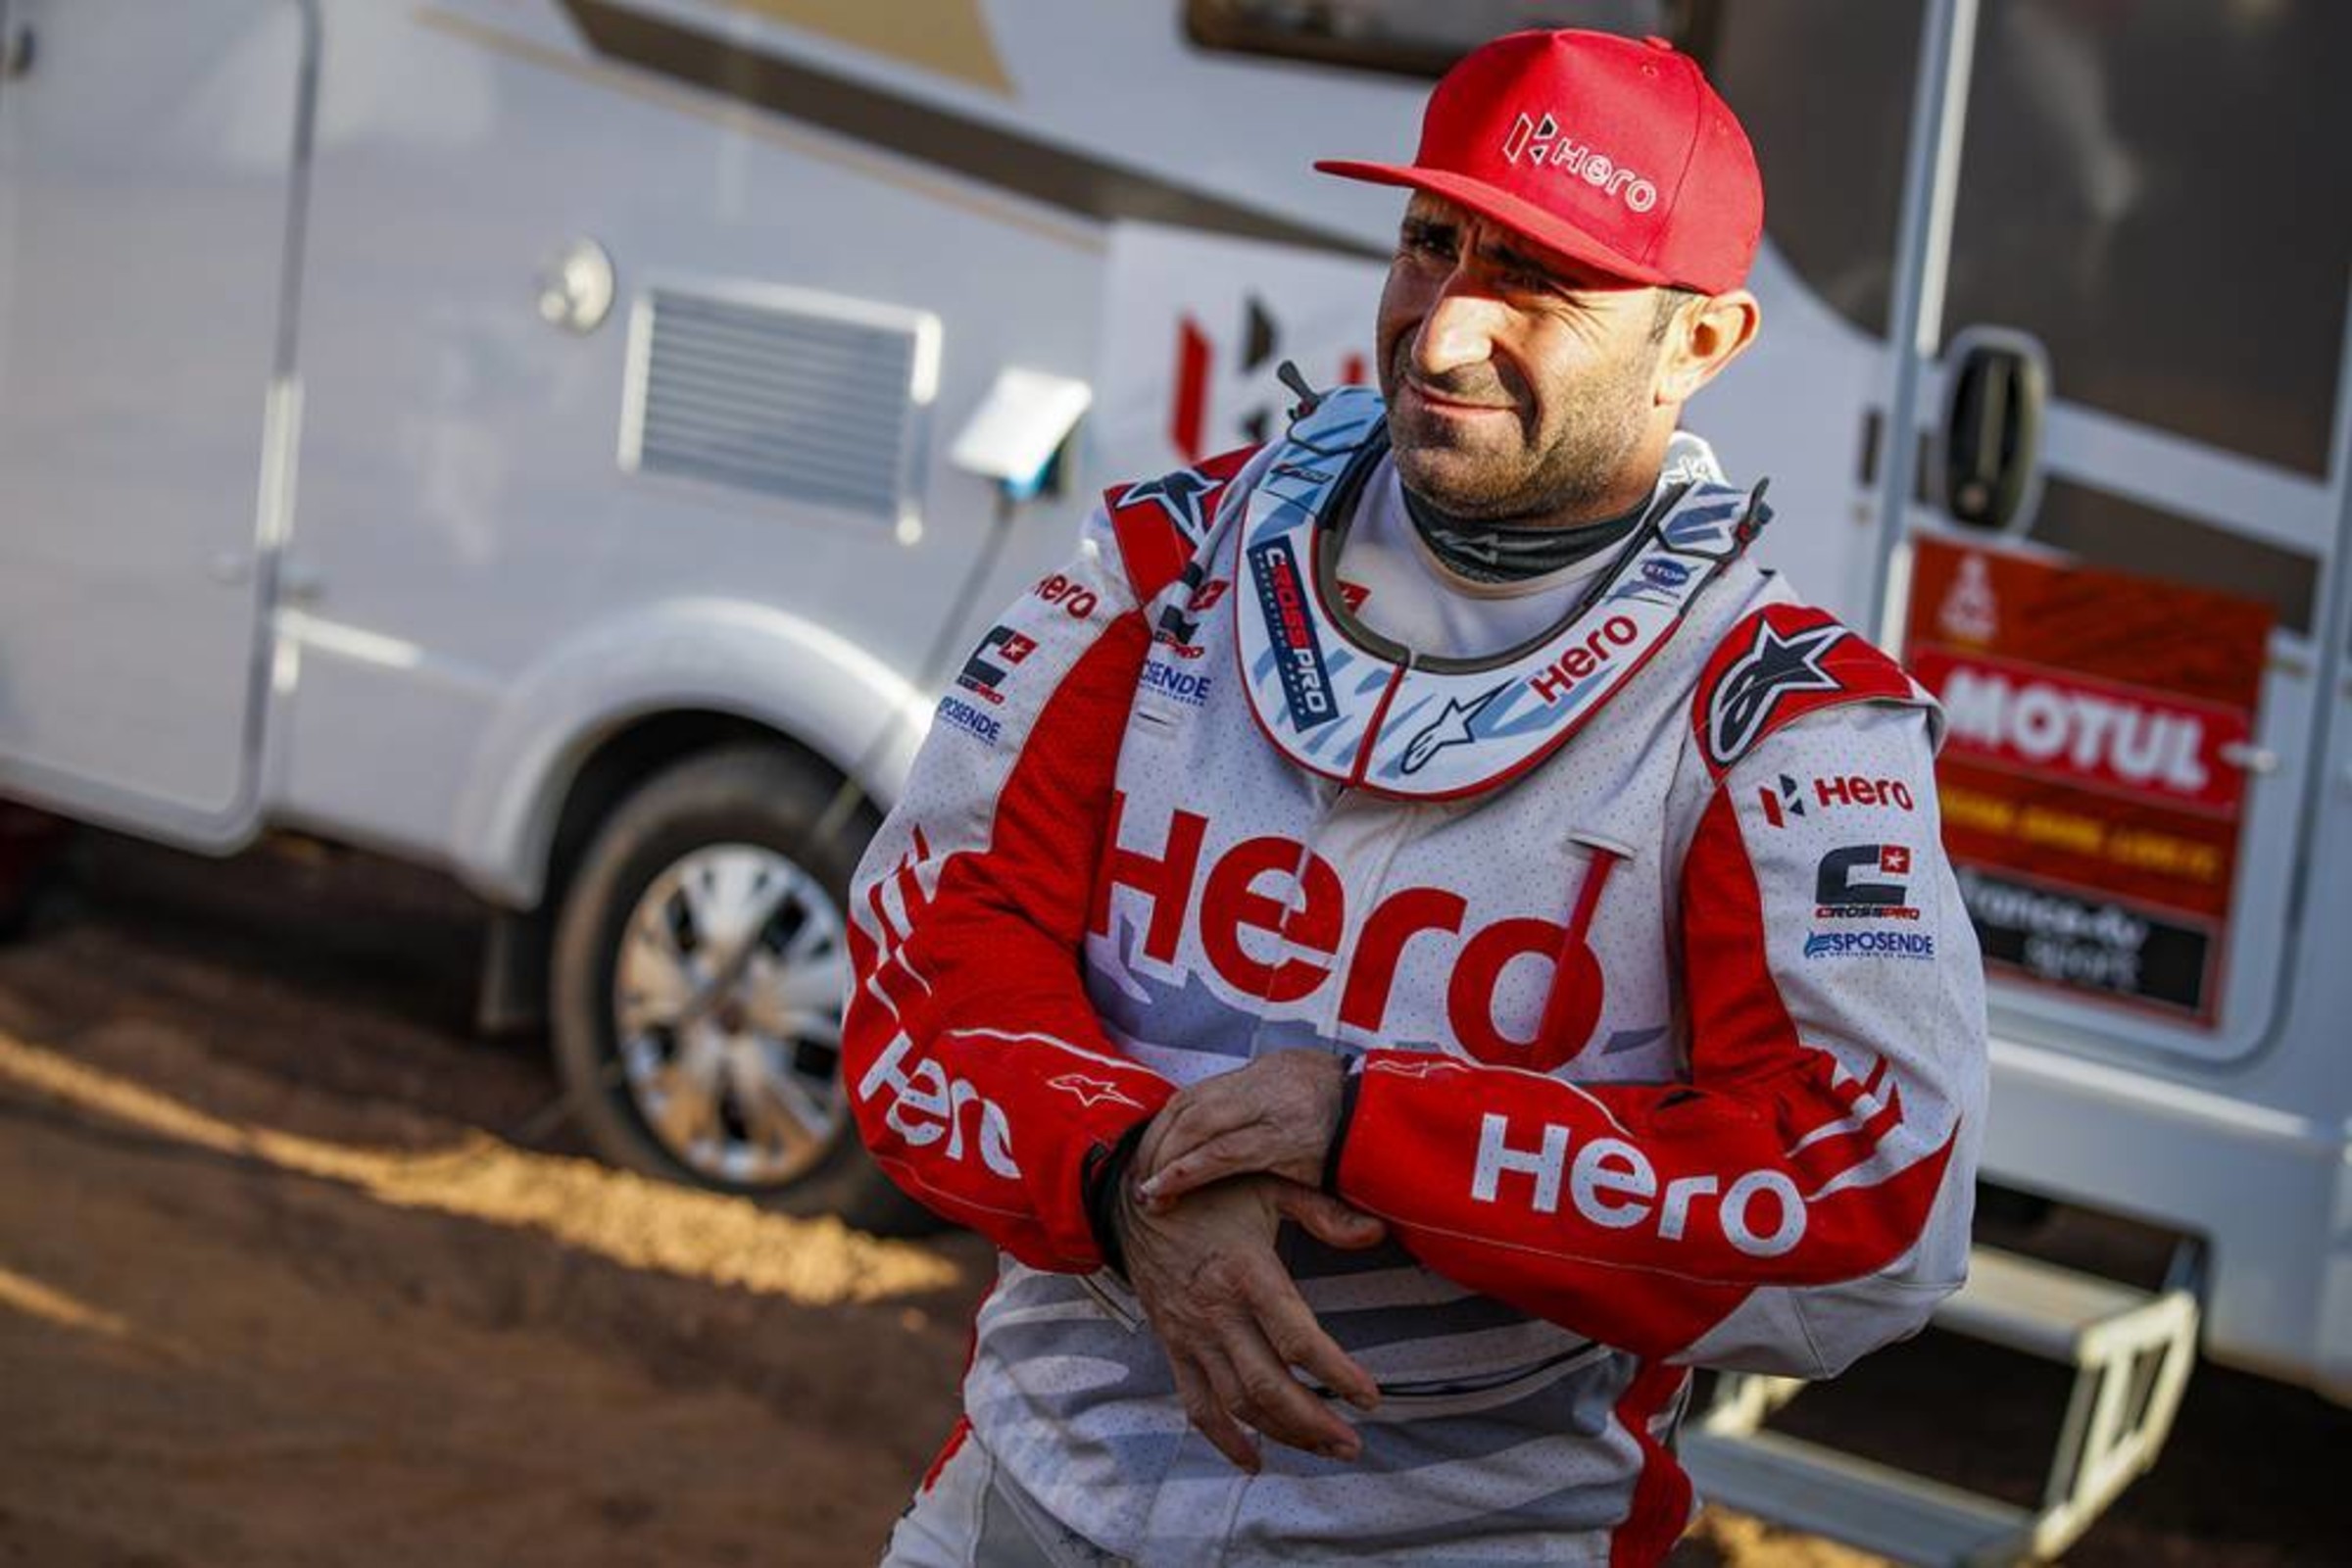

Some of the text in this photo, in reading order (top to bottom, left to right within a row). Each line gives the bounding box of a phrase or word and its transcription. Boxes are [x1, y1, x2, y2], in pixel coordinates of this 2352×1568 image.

[1551, 137, 1656, 213] Hero
[1264, 547, 1327, 713] CROSSPRO
[1530, 614, 1638, 704] Hero
[1942, 668, 2207, 792] MOTUL
[1813, 776, 1914, 811] Hero
[1088, 789, 1605, 1074] Hero
[1470, 1112, 1807, 1257] Hero
